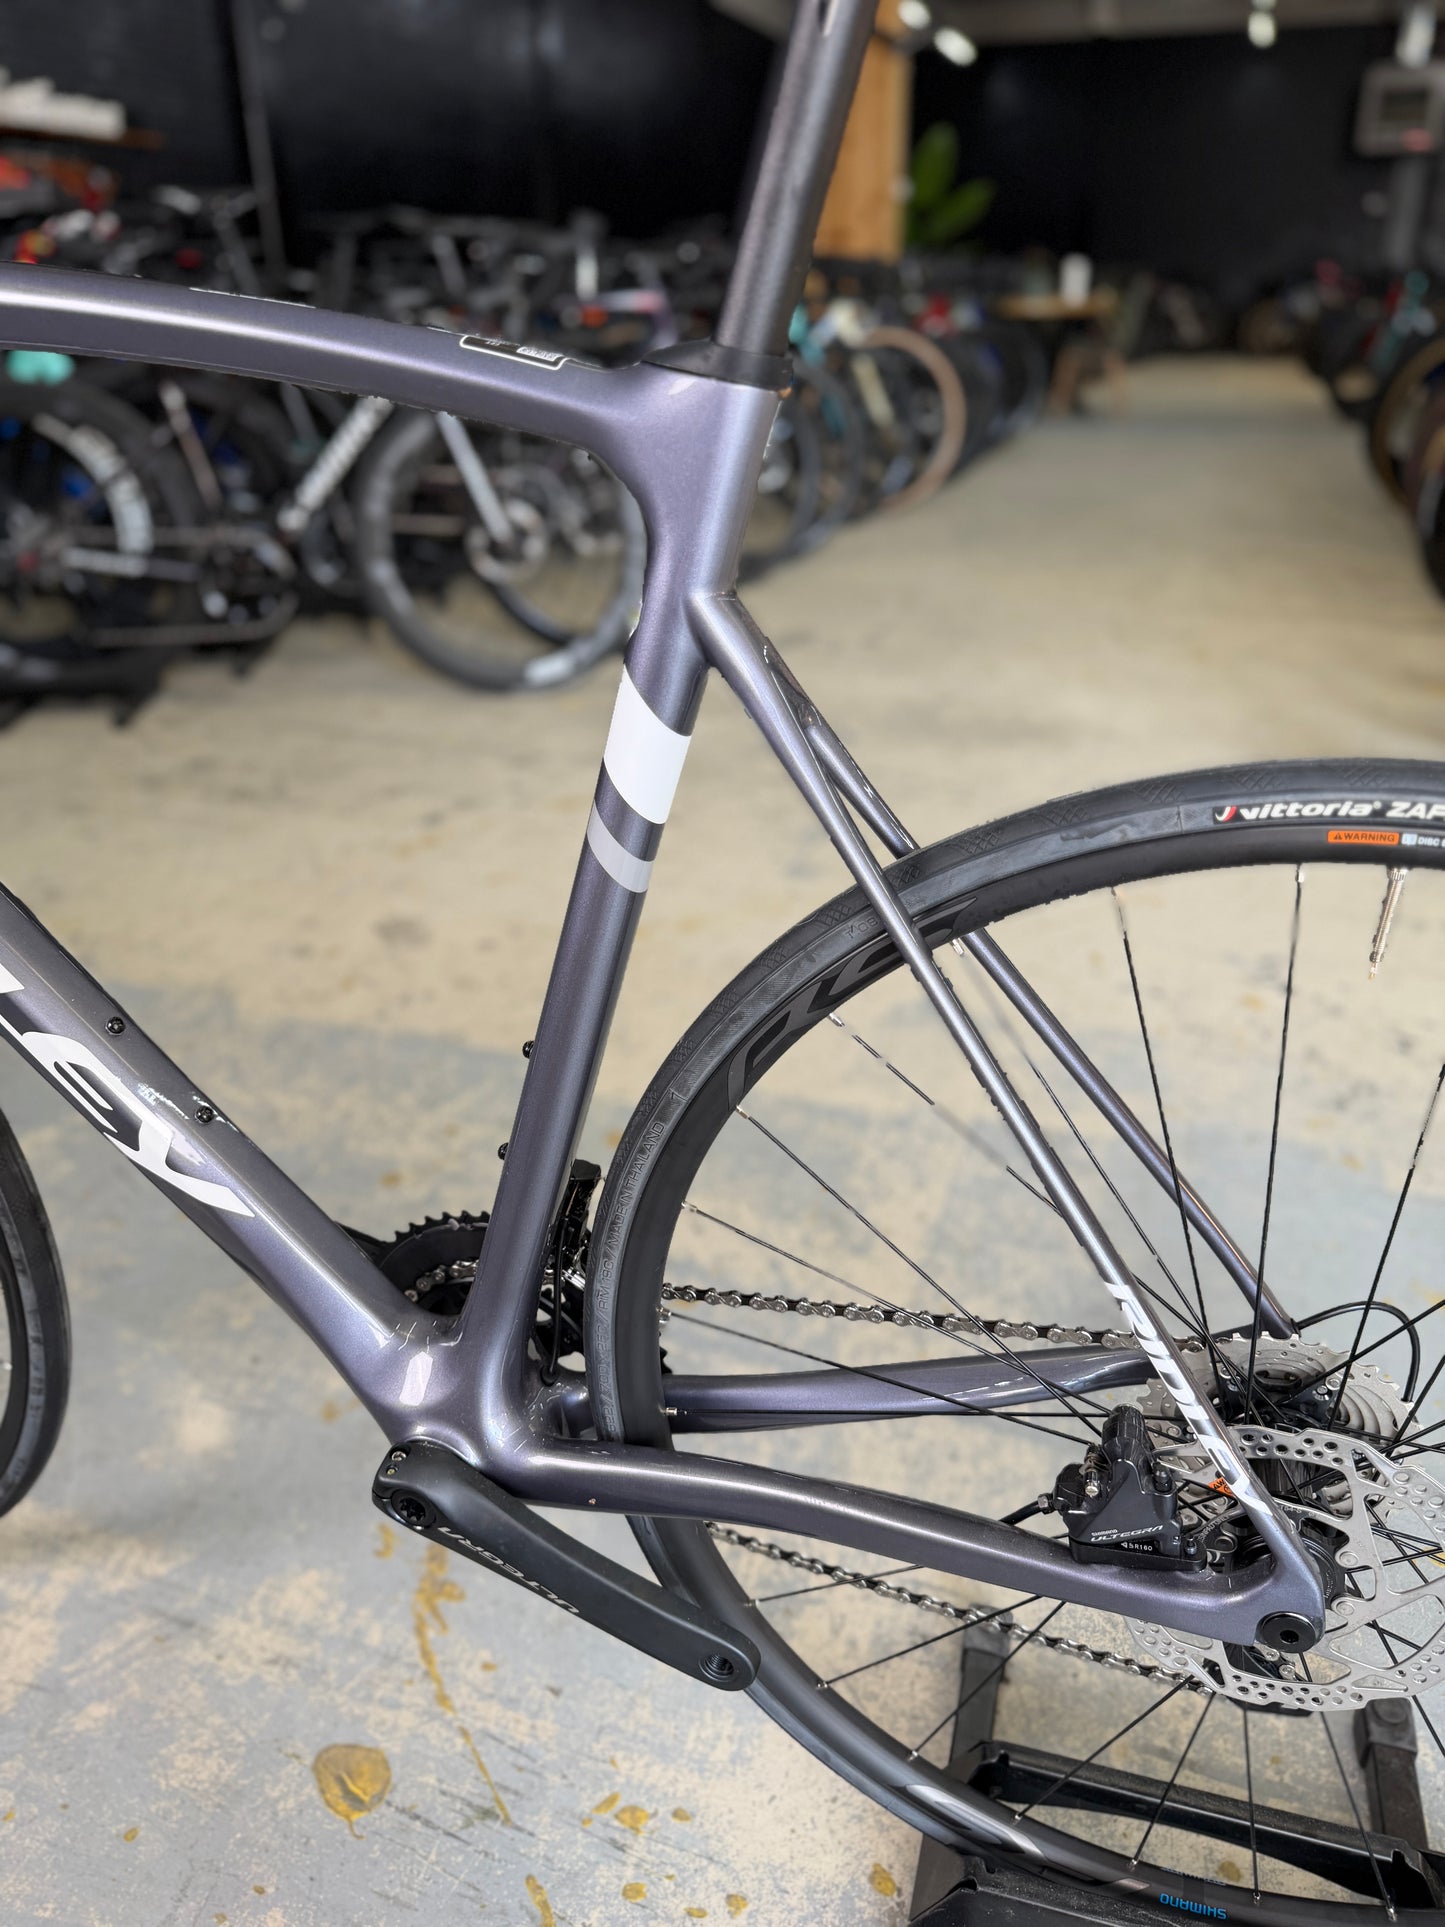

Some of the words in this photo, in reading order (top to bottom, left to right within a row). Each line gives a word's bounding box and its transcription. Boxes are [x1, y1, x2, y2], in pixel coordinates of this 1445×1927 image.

[1343, 832, 1395, 843] WARNING
[607, 1204, 628, 1246] MADE
[625, 1121, 665, 1188] THAILAND
[1104, 1281, 1273, 1516] RIDLEY
[1090, 1525, 1163, 1542] ULTEGRA
[437, 1526, 580, 1614] ULTEGRA
[1159, 1892, 1228, 1920] SHIMANO
